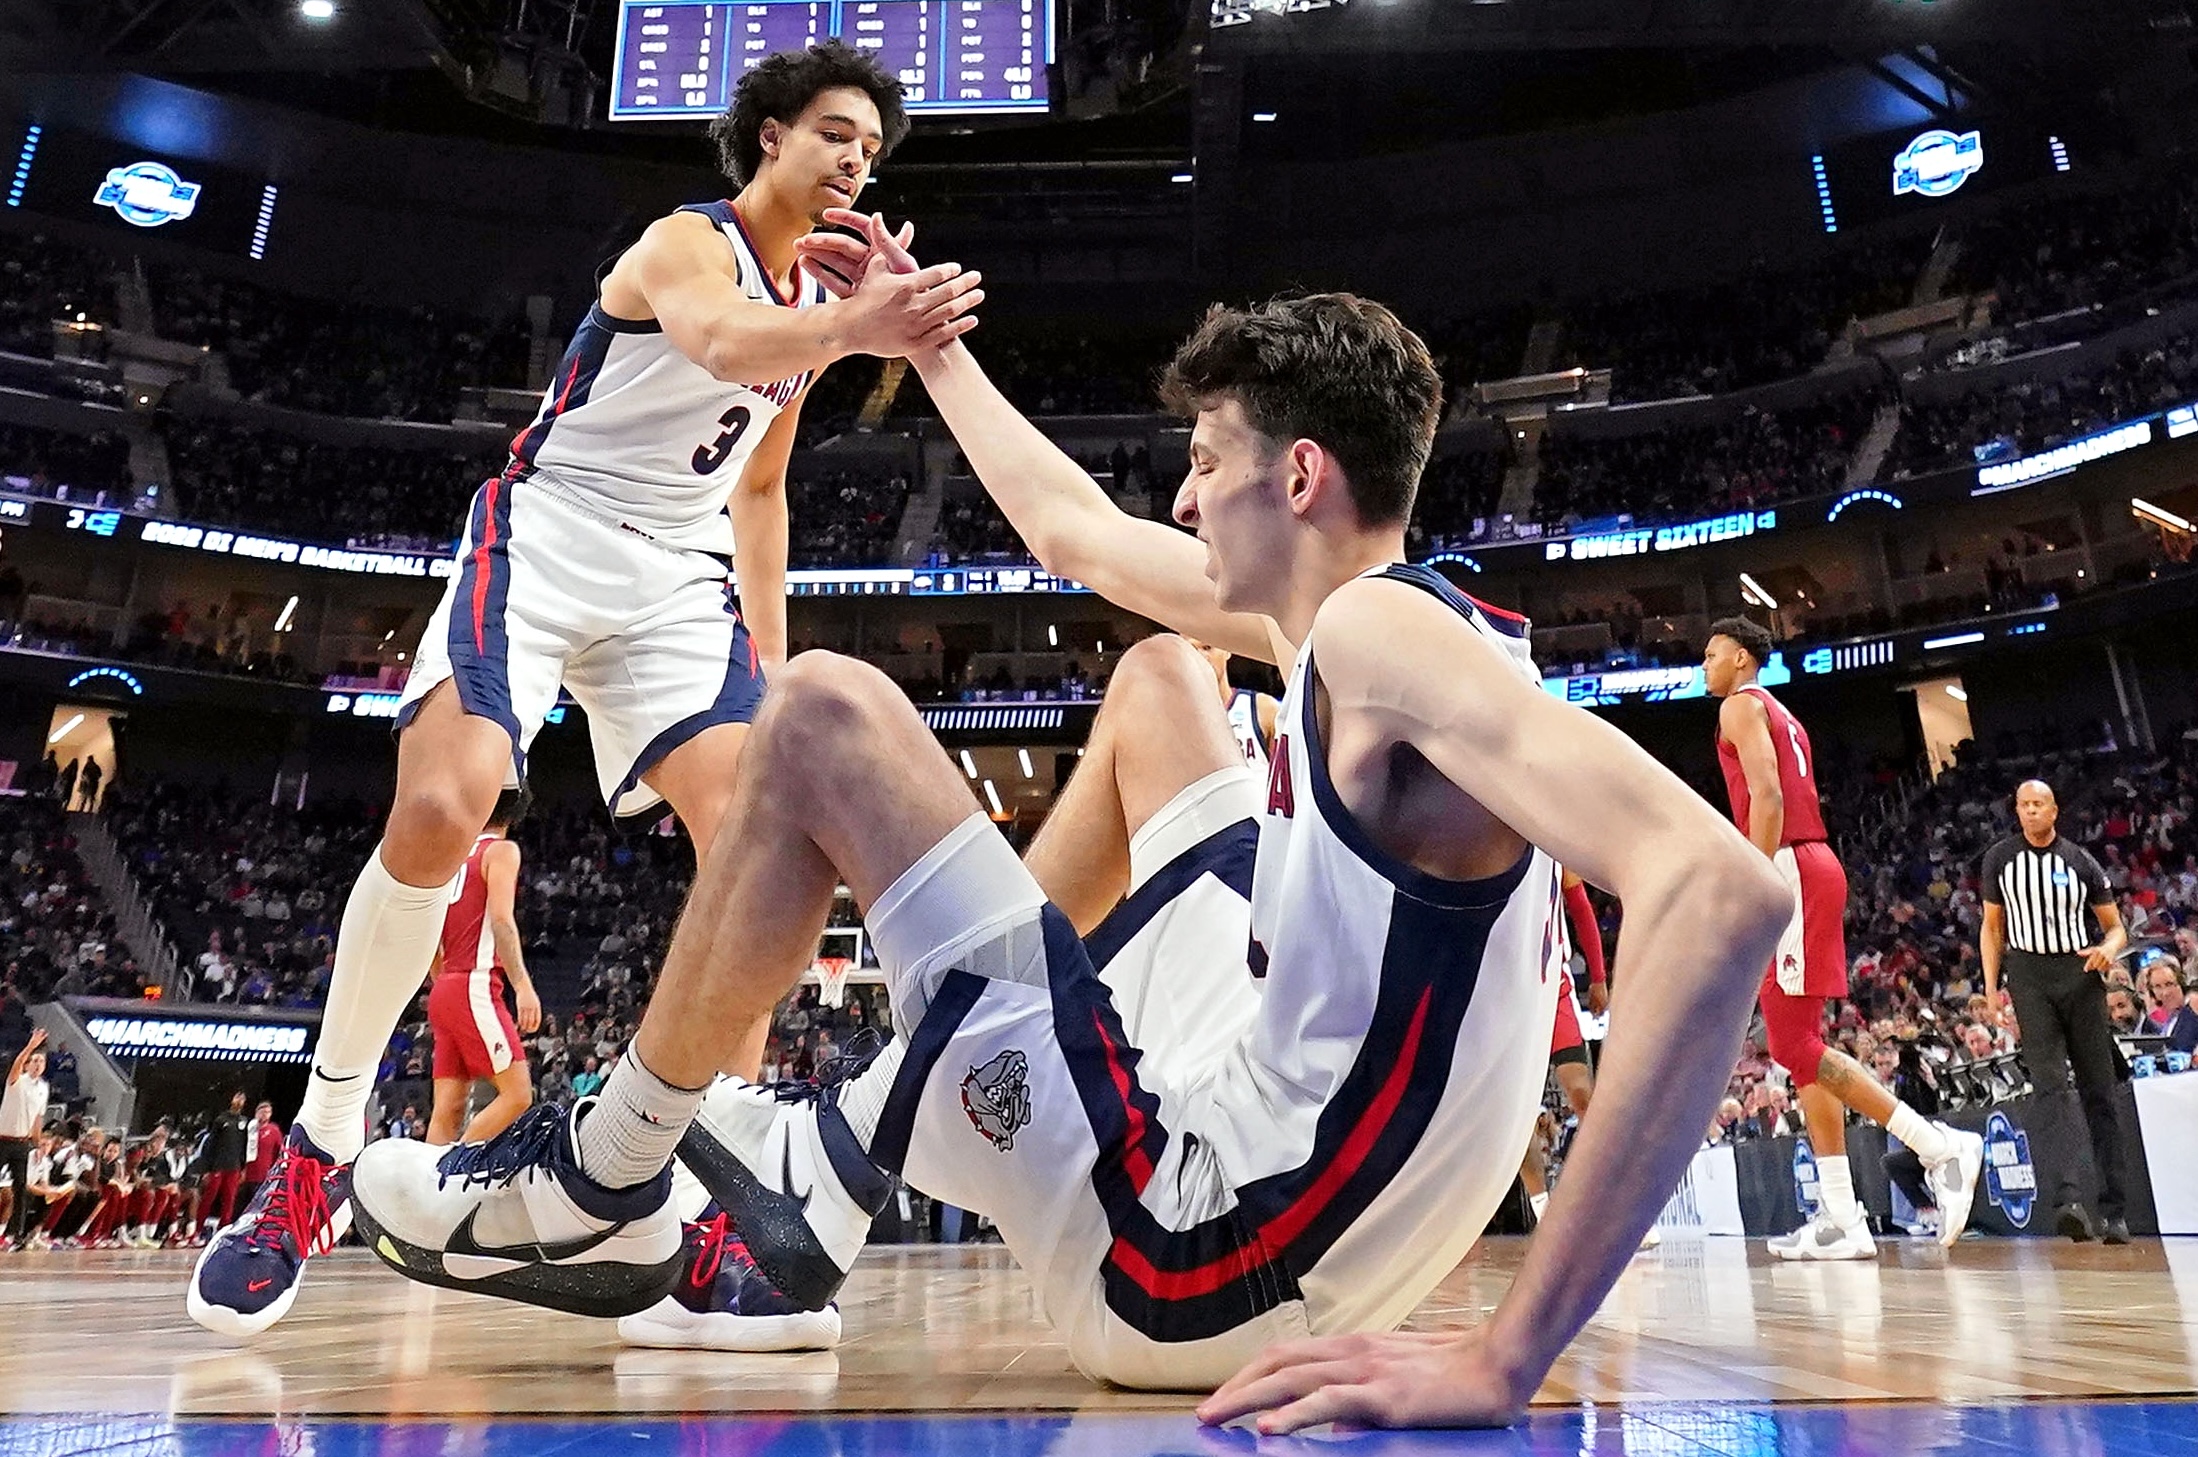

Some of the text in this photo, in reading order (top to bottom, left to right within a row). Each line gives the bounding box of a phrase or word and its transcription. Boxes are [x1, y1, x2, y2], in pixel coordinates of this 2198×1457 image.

[691, 405, 751, 476] 3
[232, 536, 300, 563] MEN'S
[299, 546, 426, 576] BASKETBALL
[1571, 512, 1754, 560] SWEET SIXTEEN
